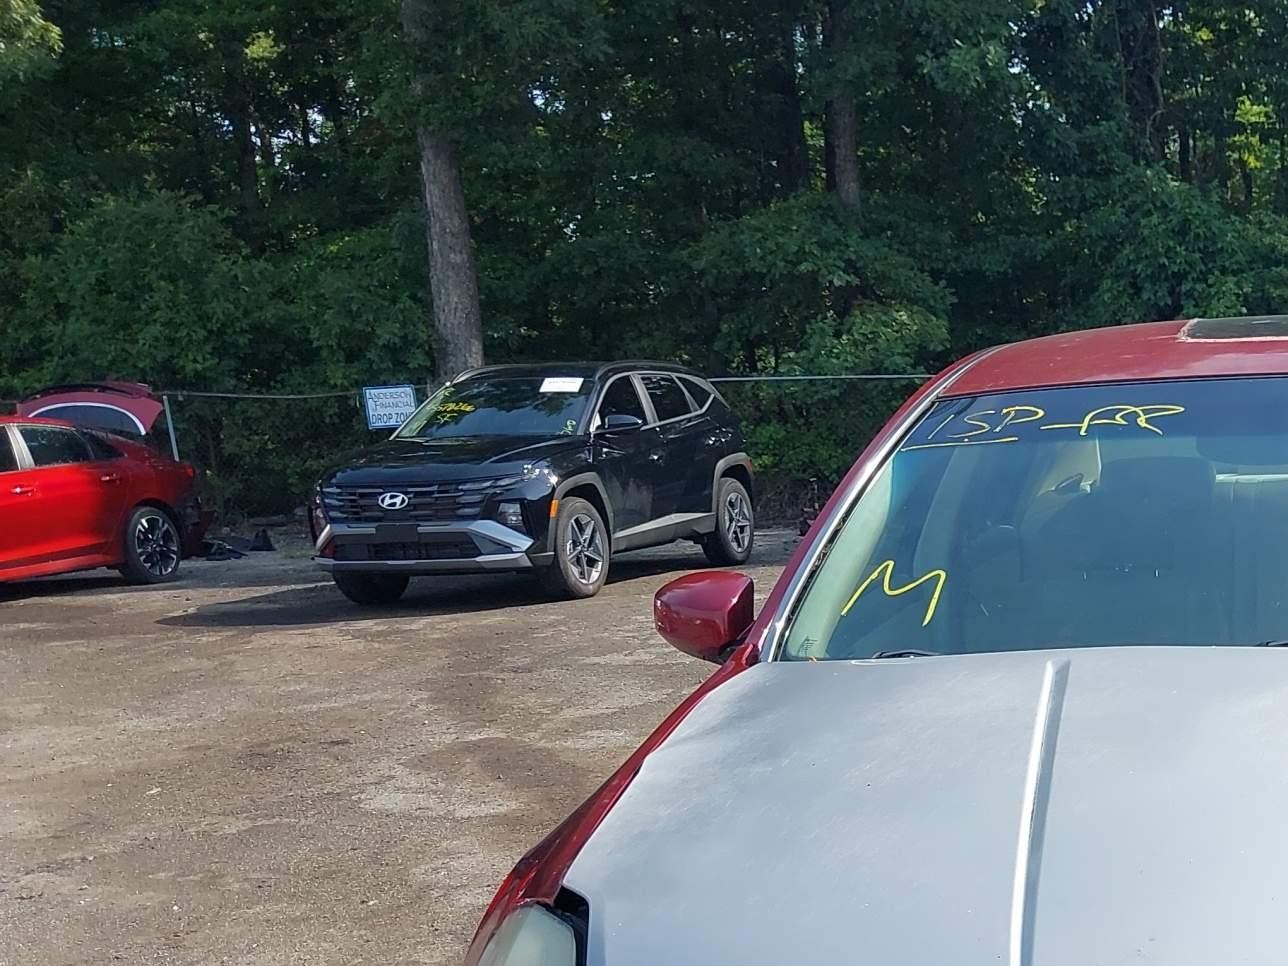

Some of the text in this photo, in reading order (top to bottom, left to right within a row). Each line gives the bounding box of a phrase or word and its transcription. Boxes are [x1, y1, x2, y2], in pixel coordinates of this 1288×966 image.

[368, 391, 412, 400] ANDERSON
[372, 413, 393, 424] DROP
[841, 560, 946, 627] M
